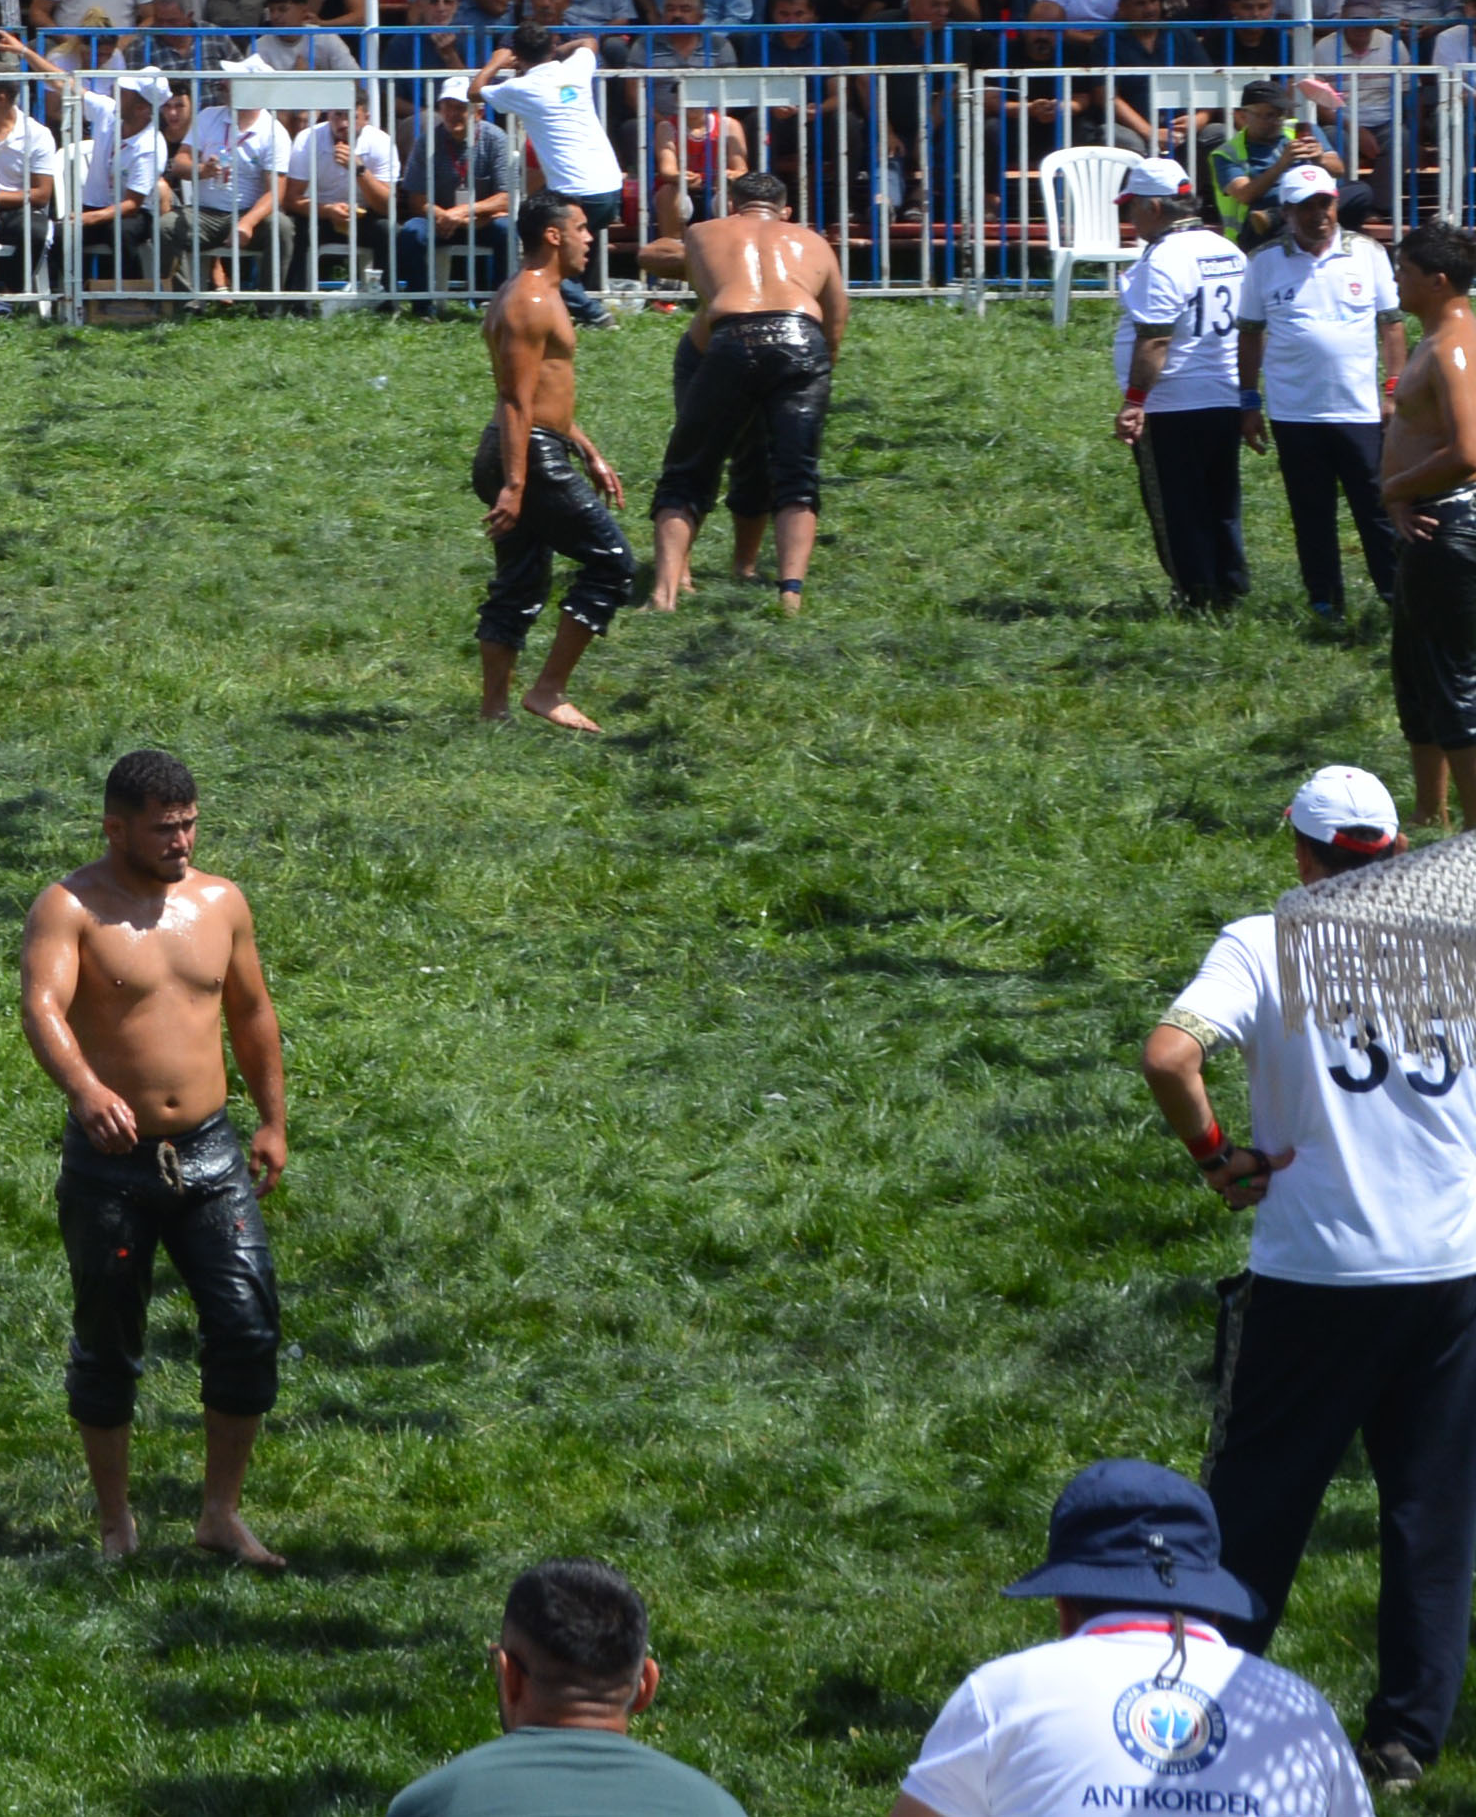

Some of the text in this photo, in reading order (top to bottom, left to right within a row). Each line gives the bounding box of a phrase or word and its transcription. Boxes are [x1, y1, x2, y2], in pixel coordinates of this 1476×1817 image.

[1187, 285, 1237, 337] 13
[1272, 287, 1295, 306] 14
[1082, 1783, 1261, 1817] ANTKORDER
